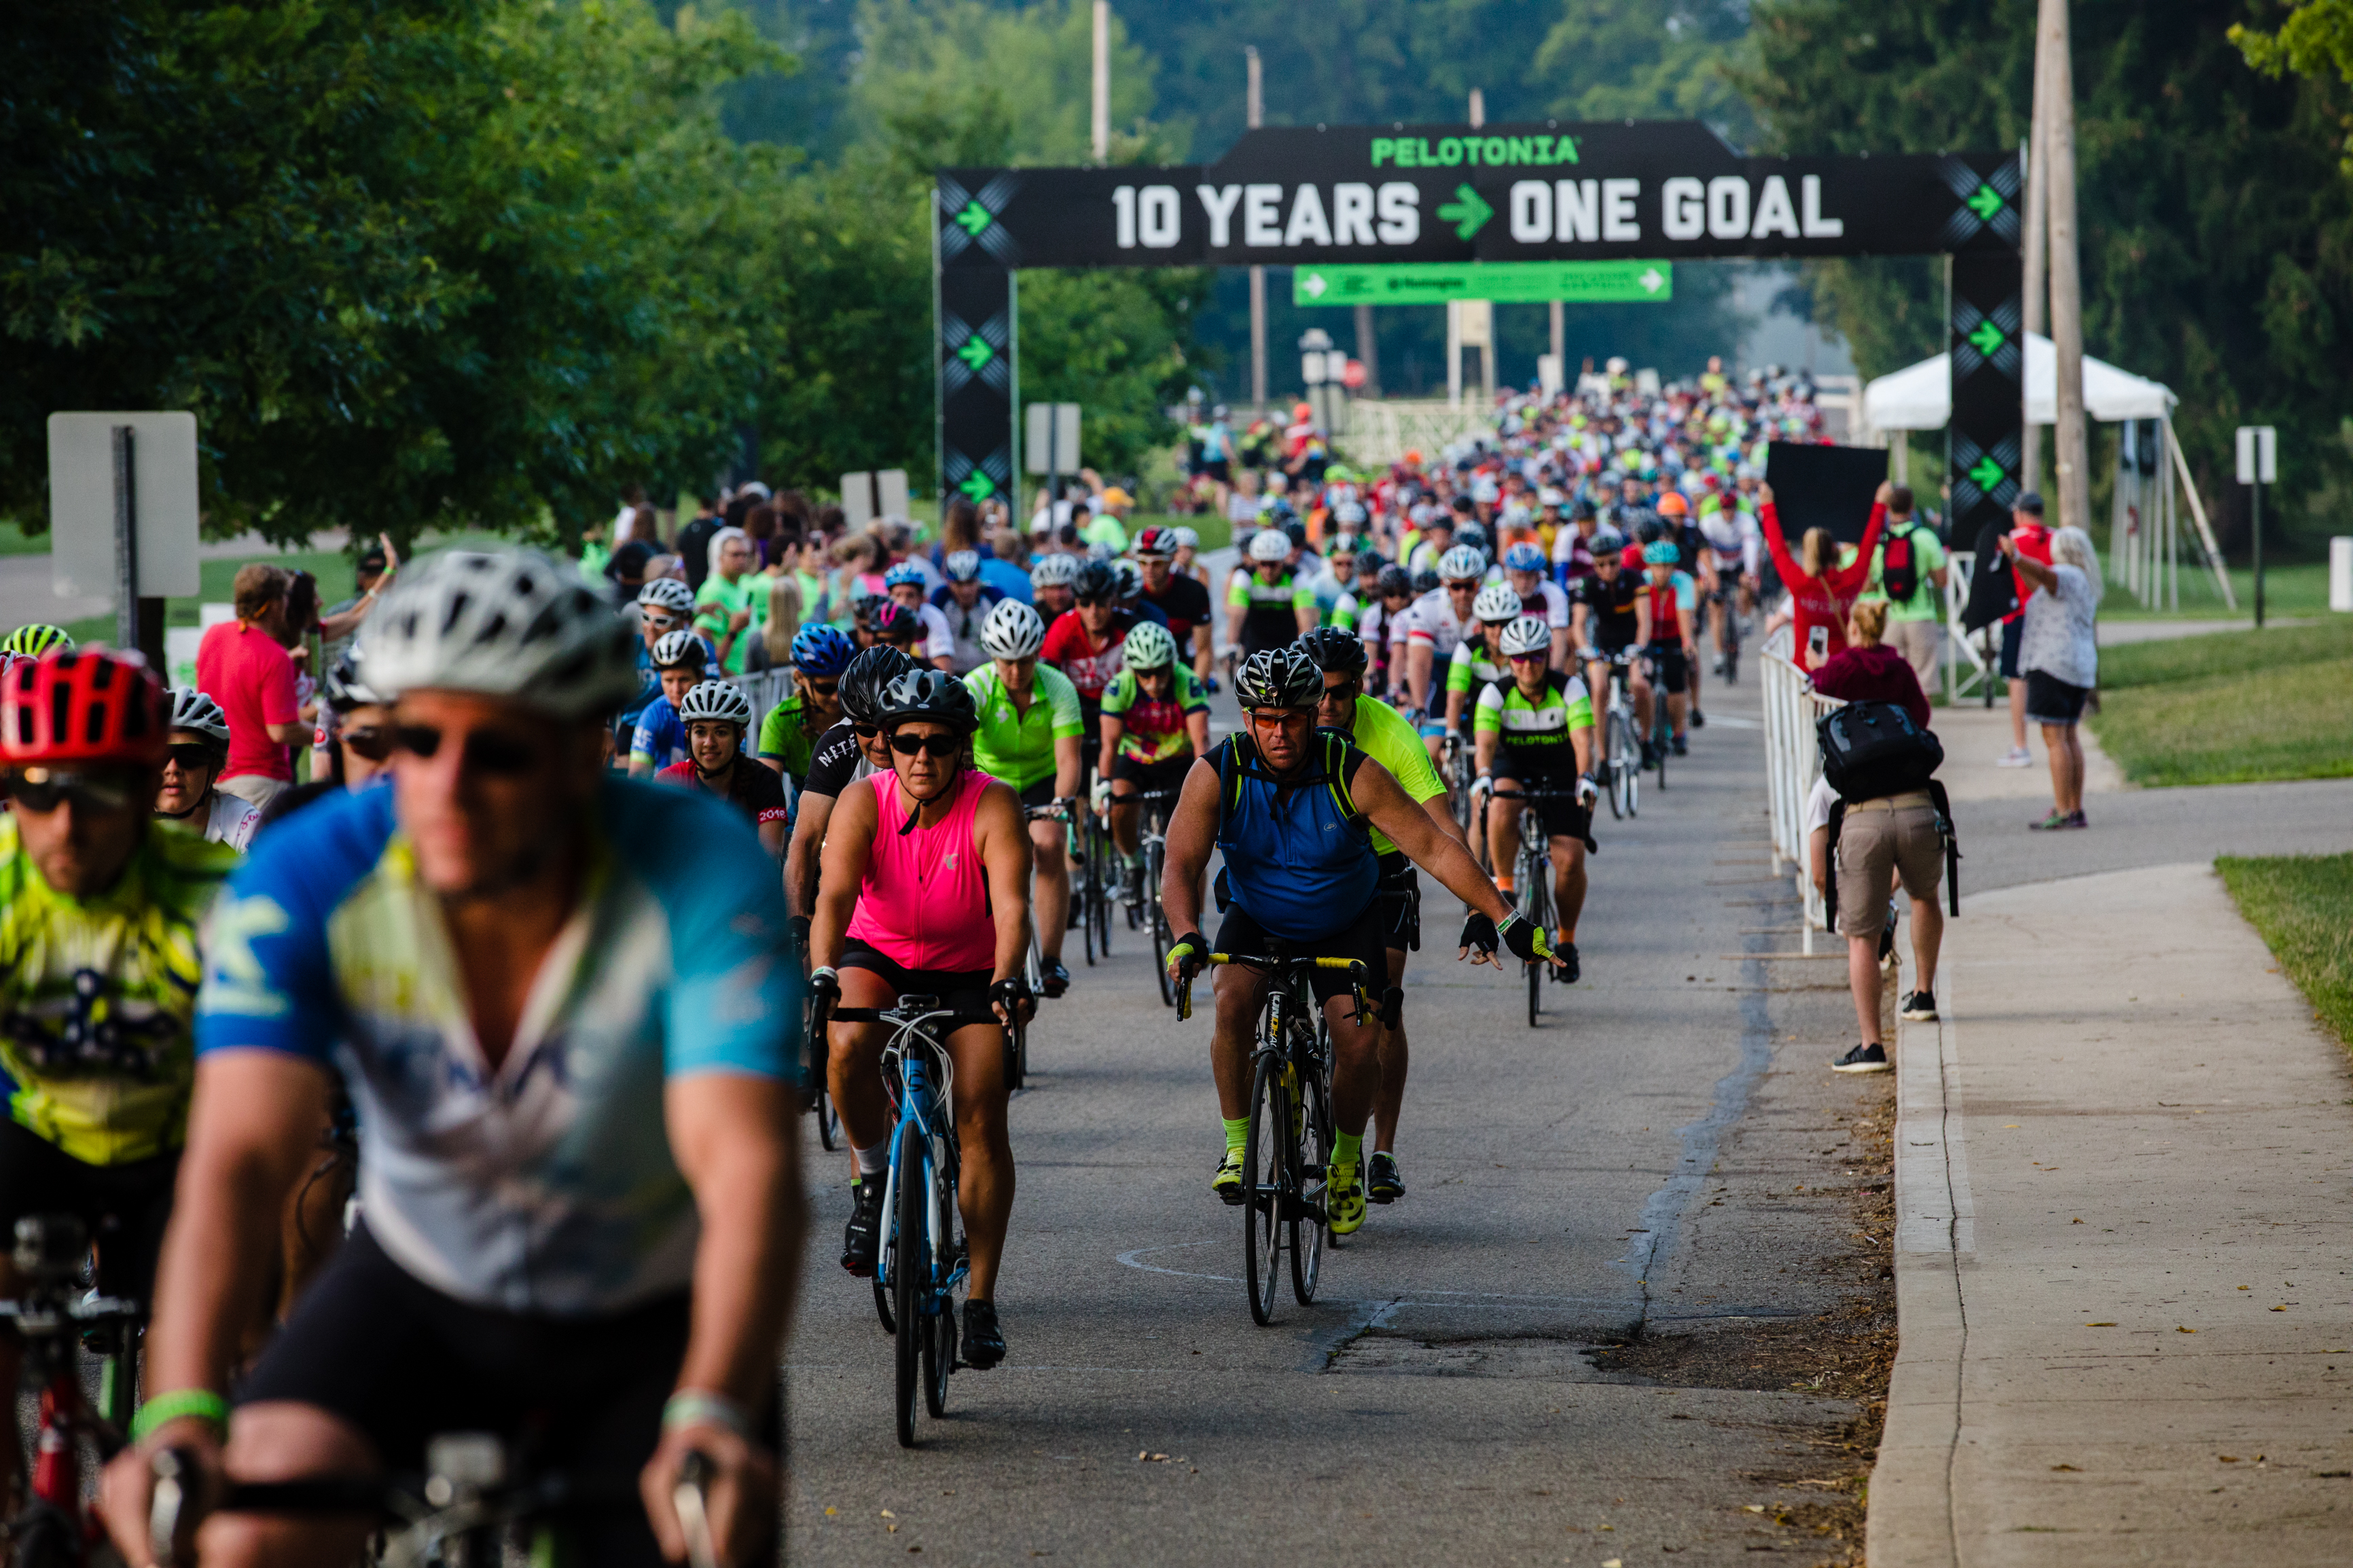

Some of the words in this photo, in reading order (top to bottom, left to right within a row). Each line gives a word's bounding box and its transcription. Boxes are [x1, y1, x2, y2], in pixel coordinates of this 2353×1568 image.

[1371, 136, 1579, 169] PELOTONIA
[1112, 185, 1181, 249] 10
[1196, 182, 1420, 247] YEARS
[1509, 178, 1641, 244] ONE
[1662, 174, 1844, 240] GOAL
[759, 809, 786, 821] 2018
